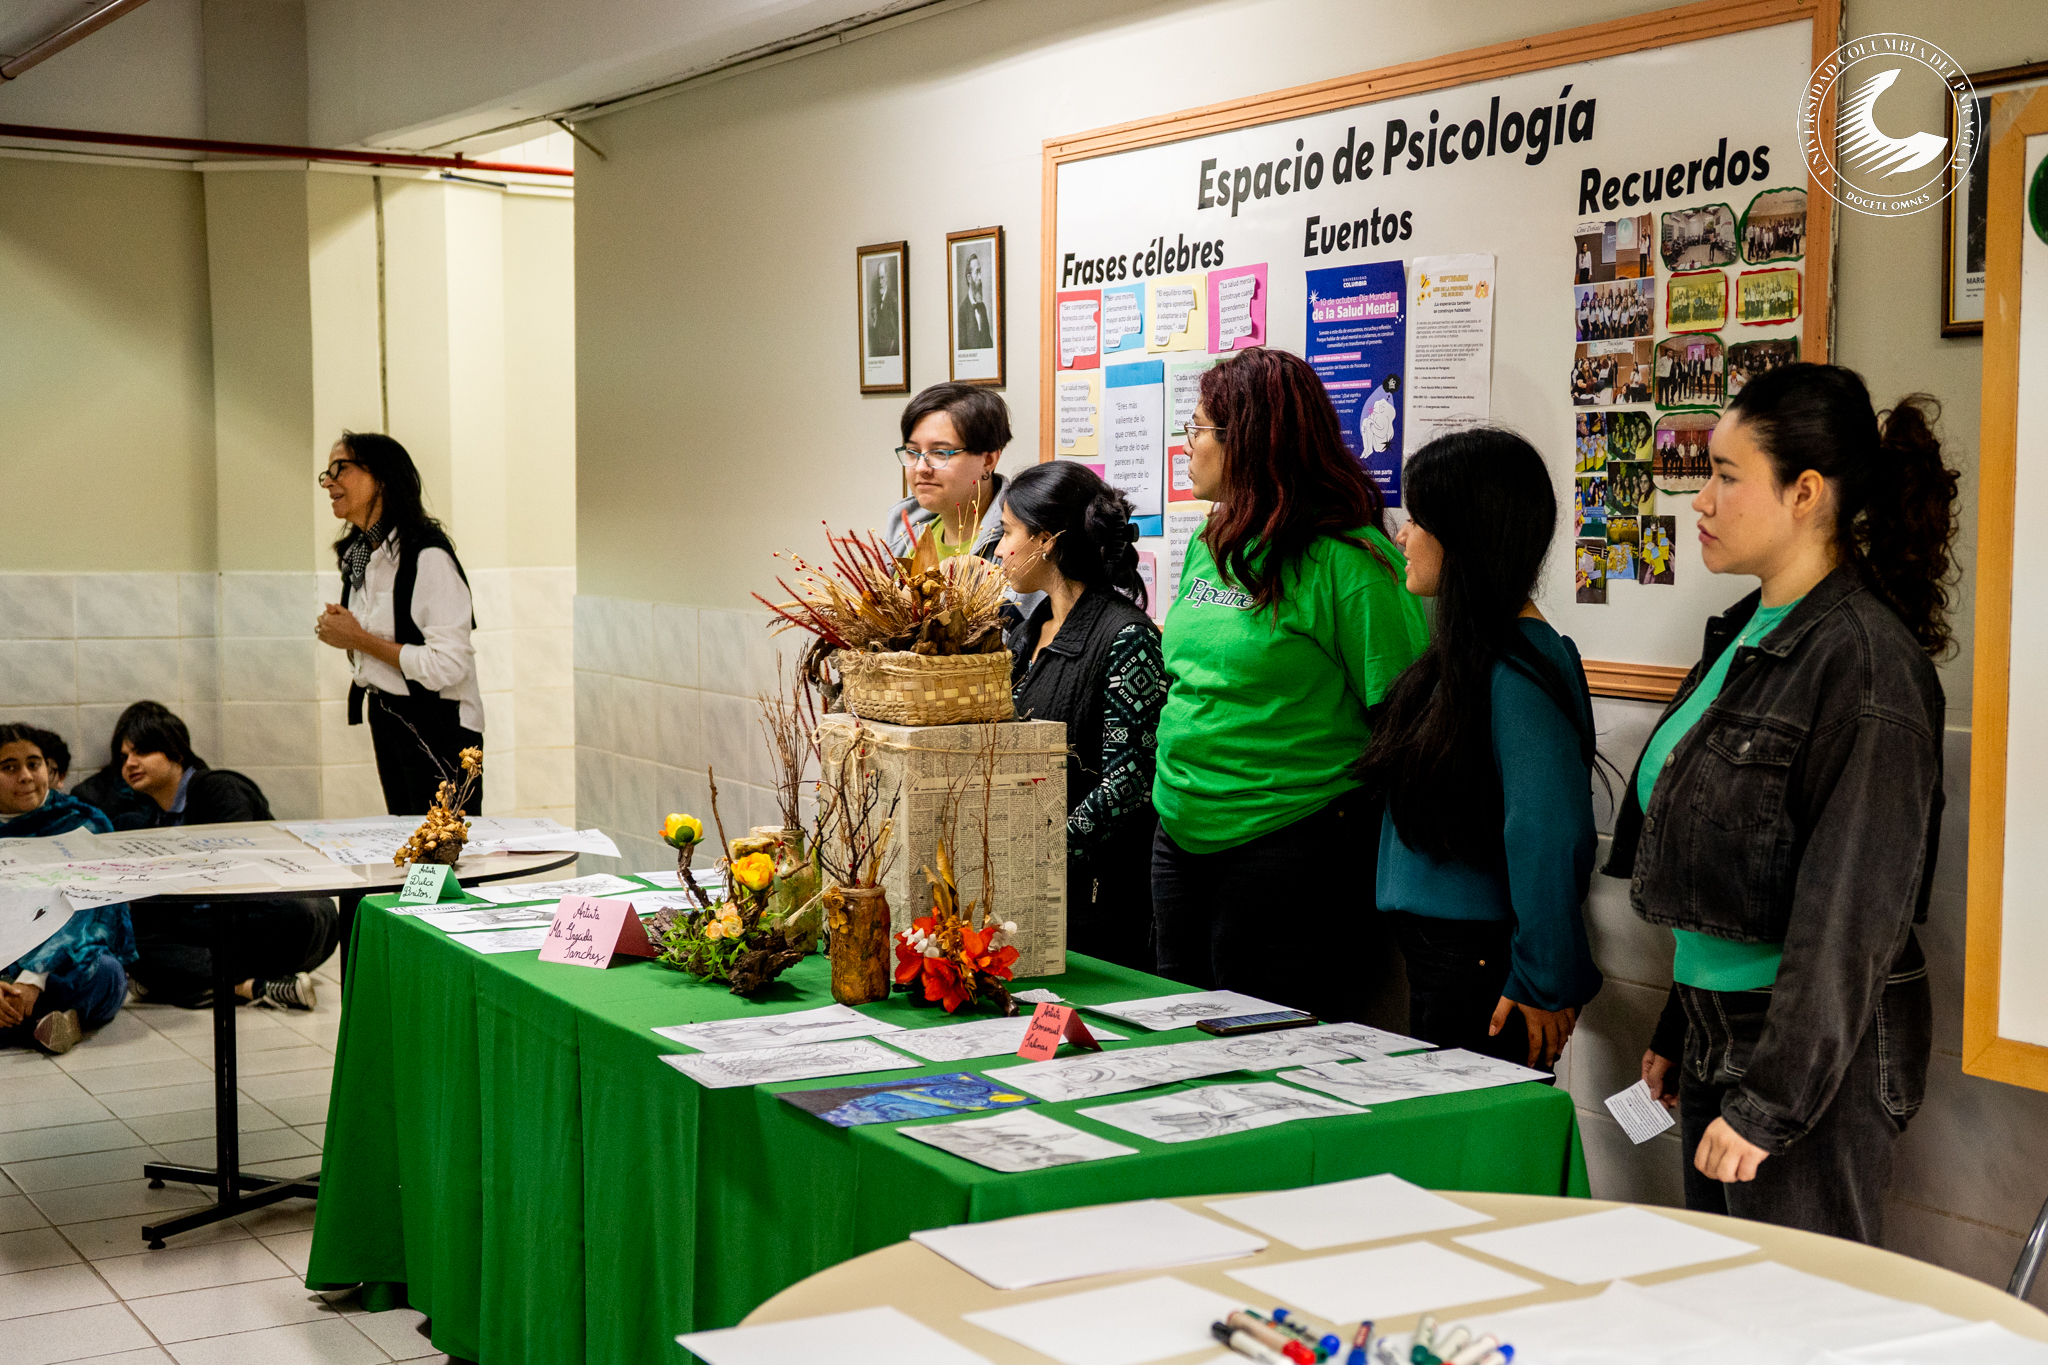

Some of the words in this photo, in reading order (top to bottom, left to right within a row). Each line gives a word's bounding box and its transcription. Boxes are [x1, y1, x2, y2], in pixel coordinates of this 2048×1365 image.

[1197, 138, 1324, 218] Espacio
[1332, 126, 1374, 185] de
[1382, 84, 1597, 176] Psicología
[1578, 137, 1771, 216] Recuerdos
[1304, 206, 1413, 258] Eventos
[1061, 252, 1127, 288] Frases
[1132, 233, 1225, 278] célebres
[1320, 298, 1326, 306] 10
[1328, 297, 1335, 305] de
[1336, 295, 1358, 304] octubre:
[1359, 294, 1368, 302] Día
[1369, 291, 1391, 301] Mundial
[1312, 308, 1324, 320] de
[1326, 307, 1335, 320] la
[1337, 304, 1363, 318] Salud
[1366, 300, 1399, 316] Mental
[1114, 459, 1131, 467] pareces
[1114, 471, 1137, 481] inteligente
[410, 874, 434, 886] Dulce
[573, 901, 600, 920] Artista
